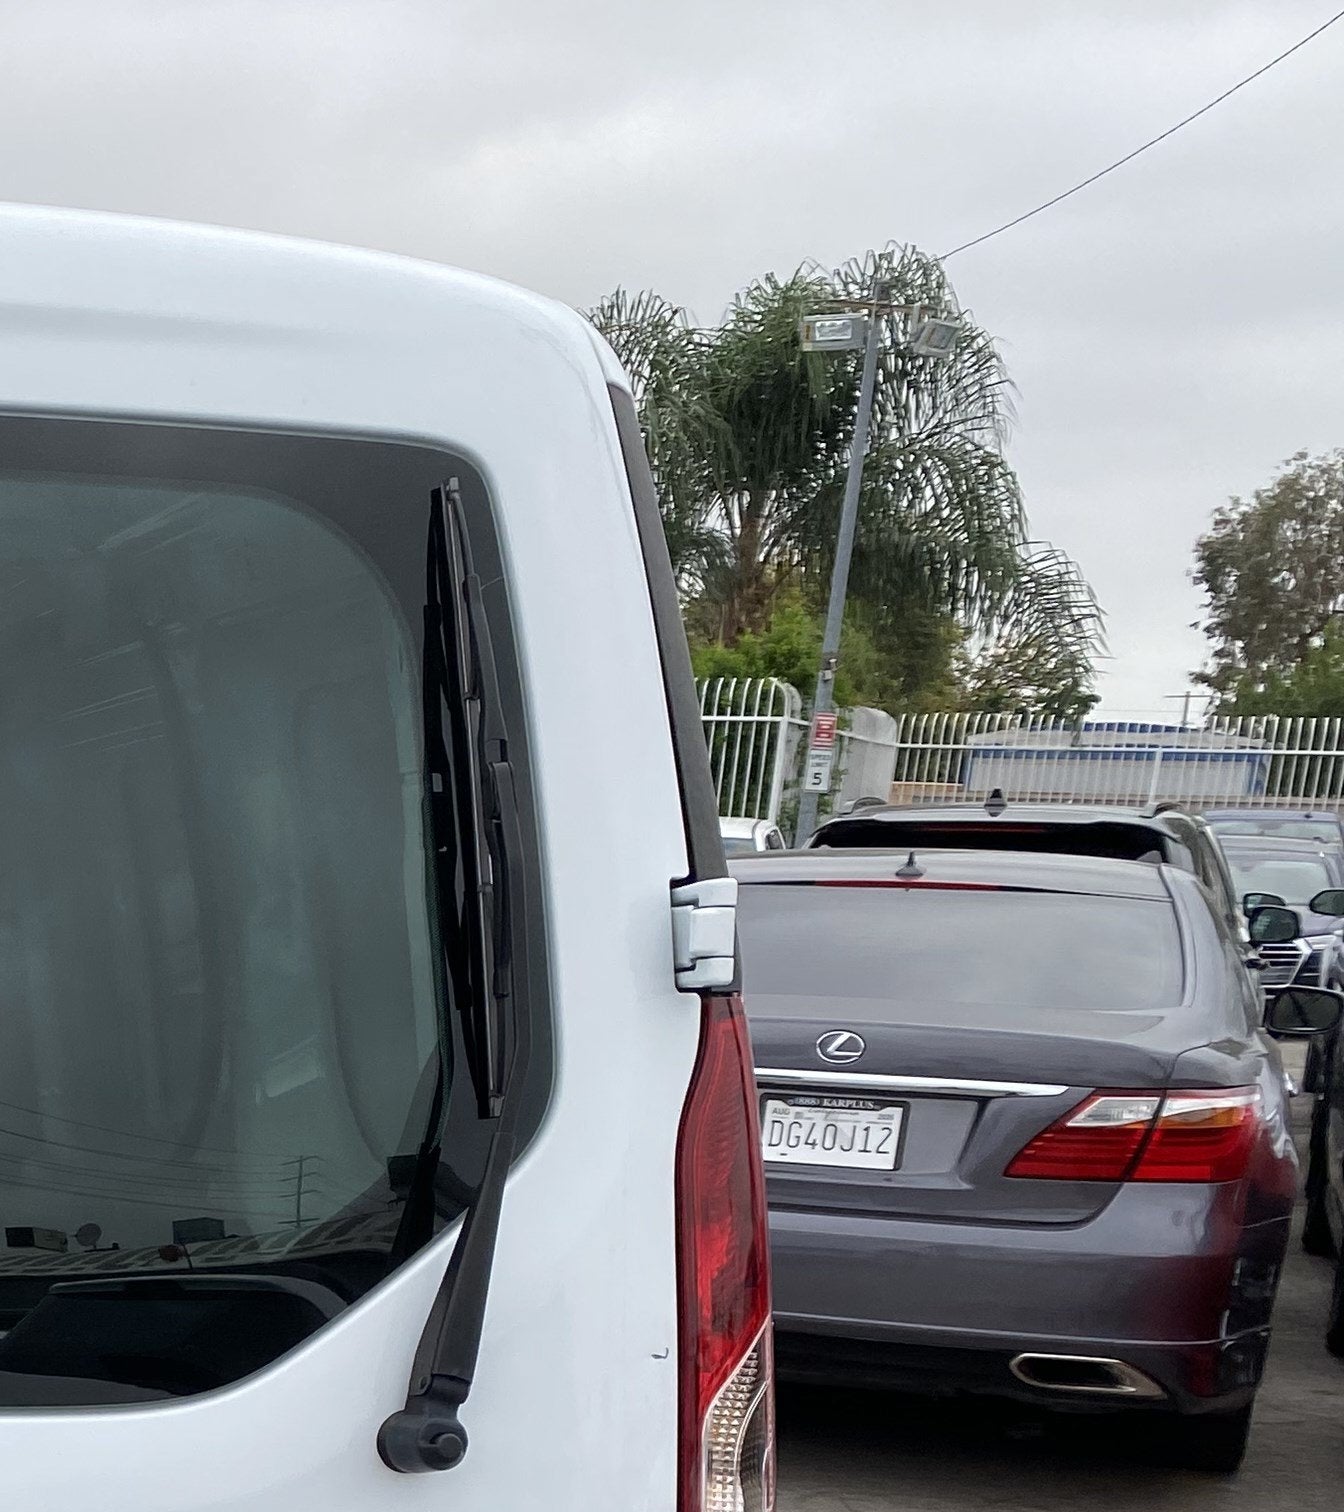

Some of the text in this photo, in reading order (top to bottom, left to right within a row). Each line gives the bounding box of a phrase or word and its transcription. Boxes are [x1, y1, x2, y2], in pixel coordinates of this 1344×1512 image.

[811, 772, 823, 786] 5
[822, 1098, 875, 1109] KARPLUS
[772, 1107, 790, 1115] AUG
[768, 1120, 893, 1154] DG40J12
